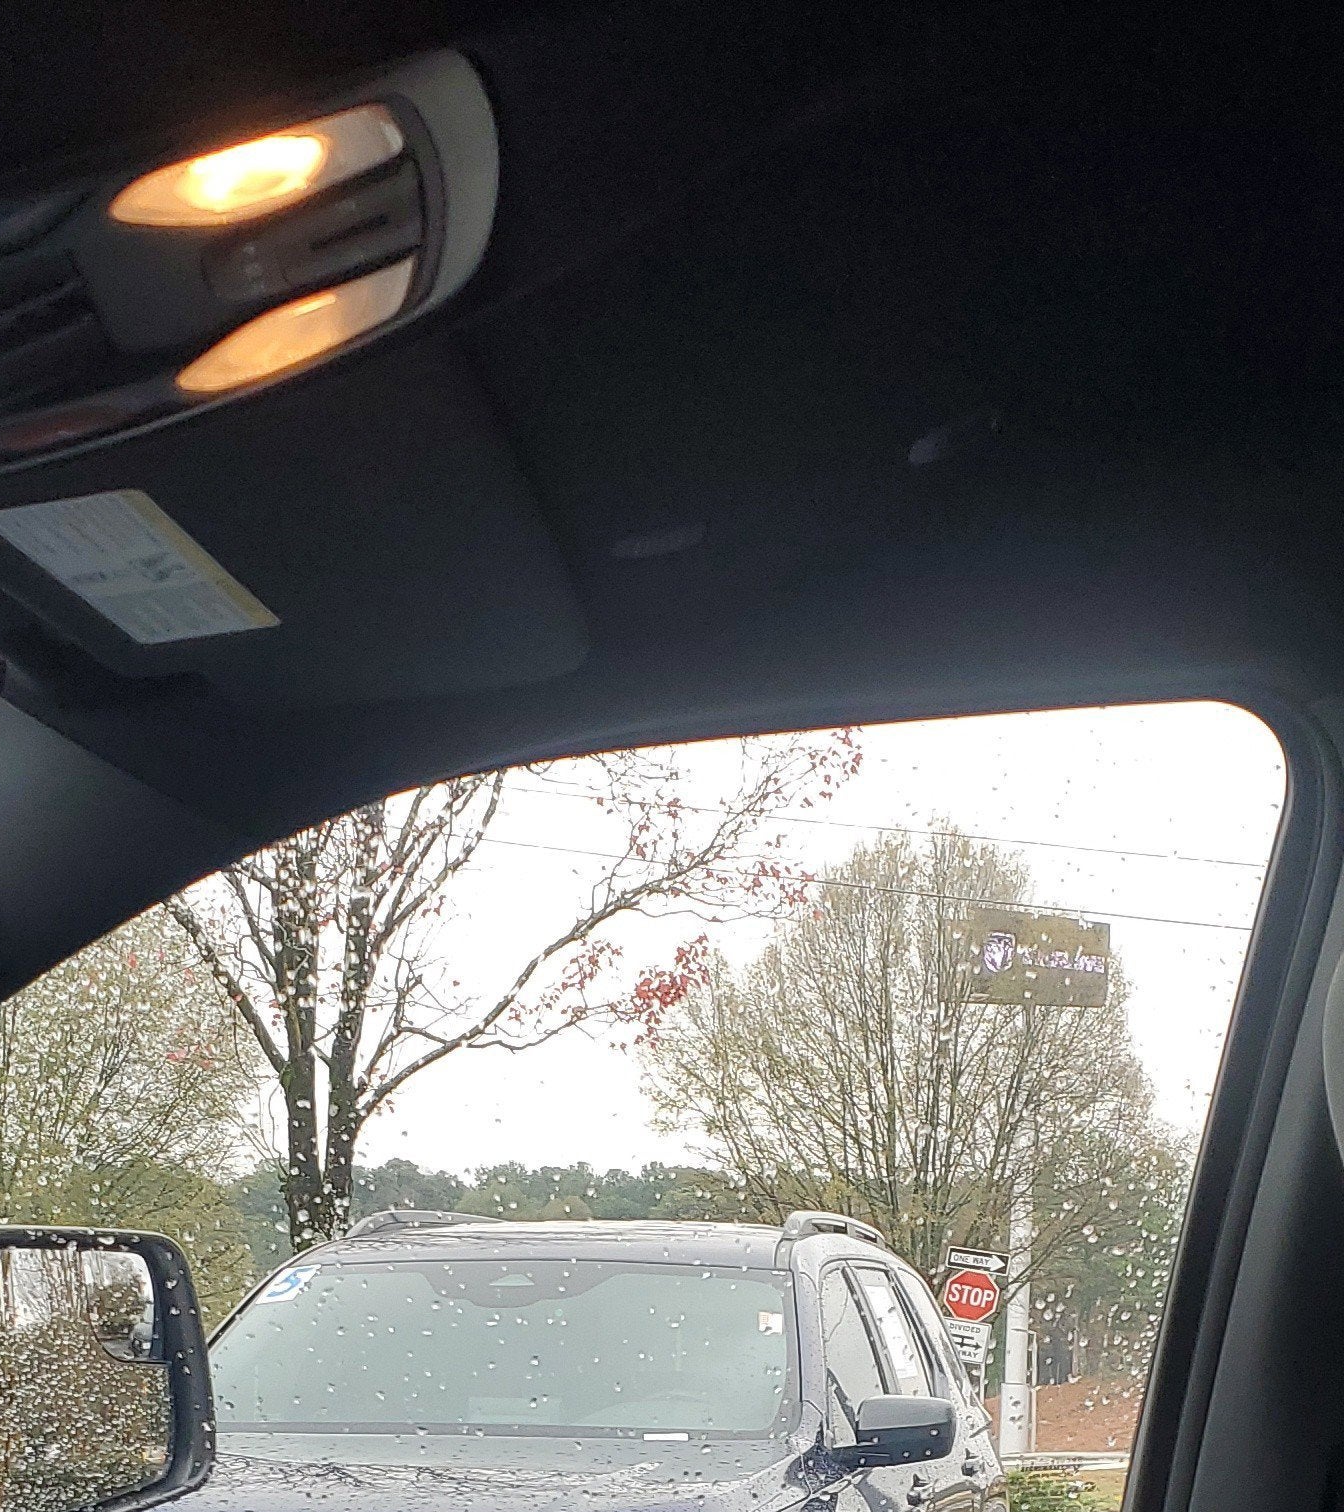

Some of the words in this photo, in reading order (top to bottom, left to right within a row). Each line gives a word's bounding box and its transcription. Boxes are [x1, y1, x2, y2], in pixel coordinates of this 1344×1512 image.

[953, 1253, 970, 1264] ONE
[972, 1256, 991, 1266] WAY
[948, 1283, 995, 1308] STOP
[949, 1322, 981, 1334] DIVIDED
